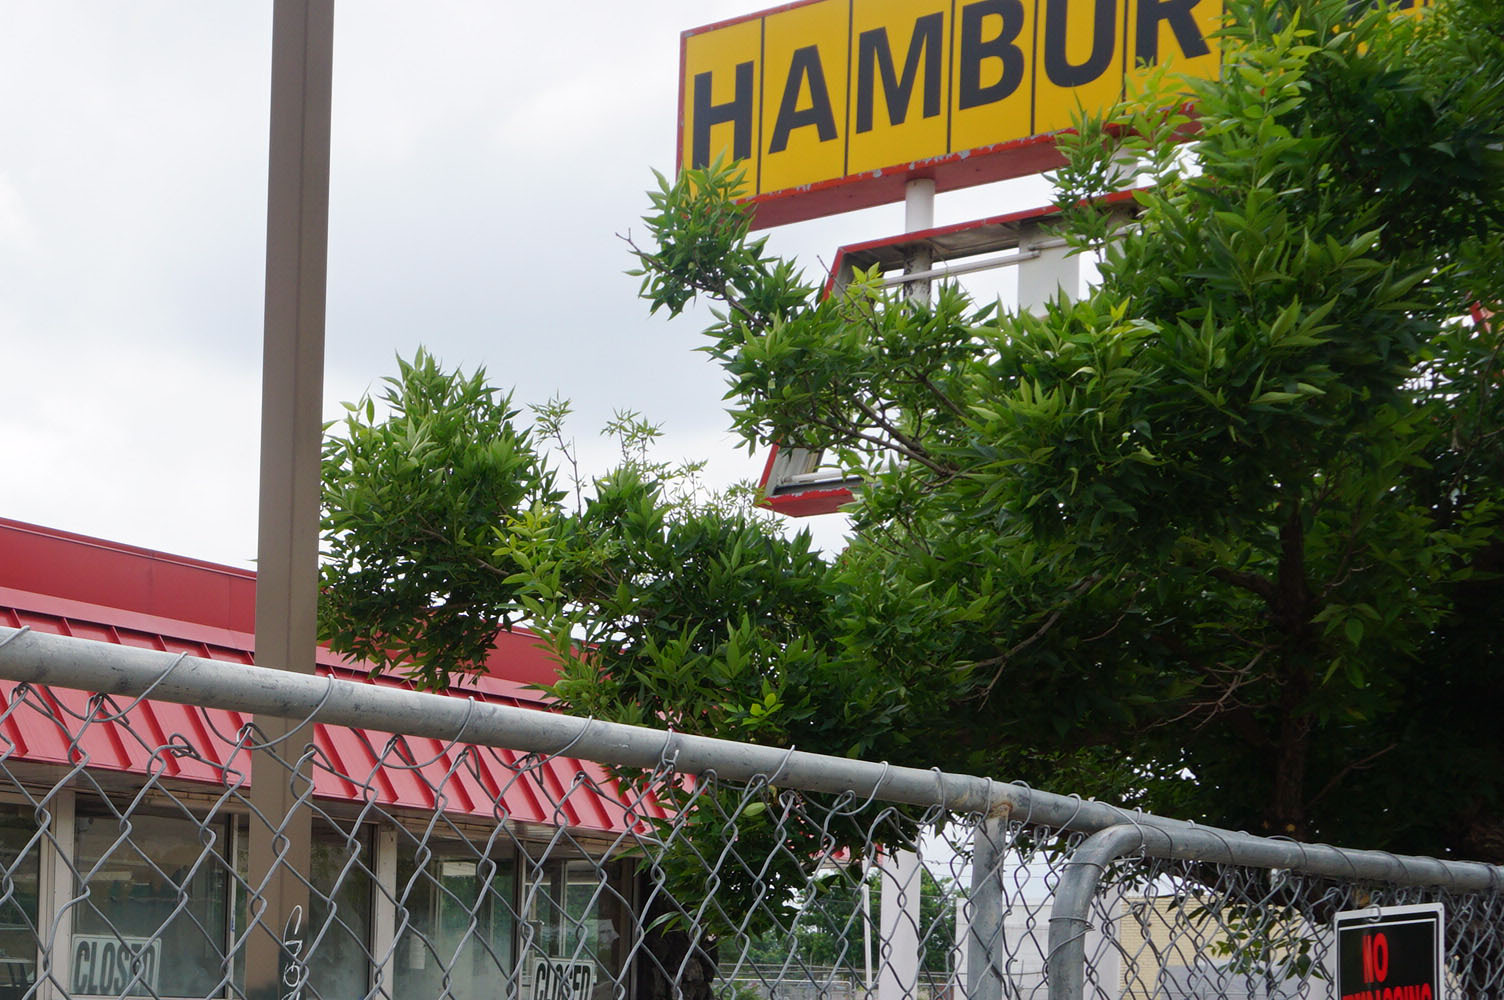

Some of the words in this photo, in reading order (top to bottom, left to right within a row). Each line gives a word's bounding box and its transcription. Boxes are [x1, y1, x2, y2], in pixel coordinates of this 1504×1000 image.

[690, 0, 1212, 166] HAMBUR
[73, 941, 156, 995] CLOSED
[1362, 932, 1389, 984] NO
